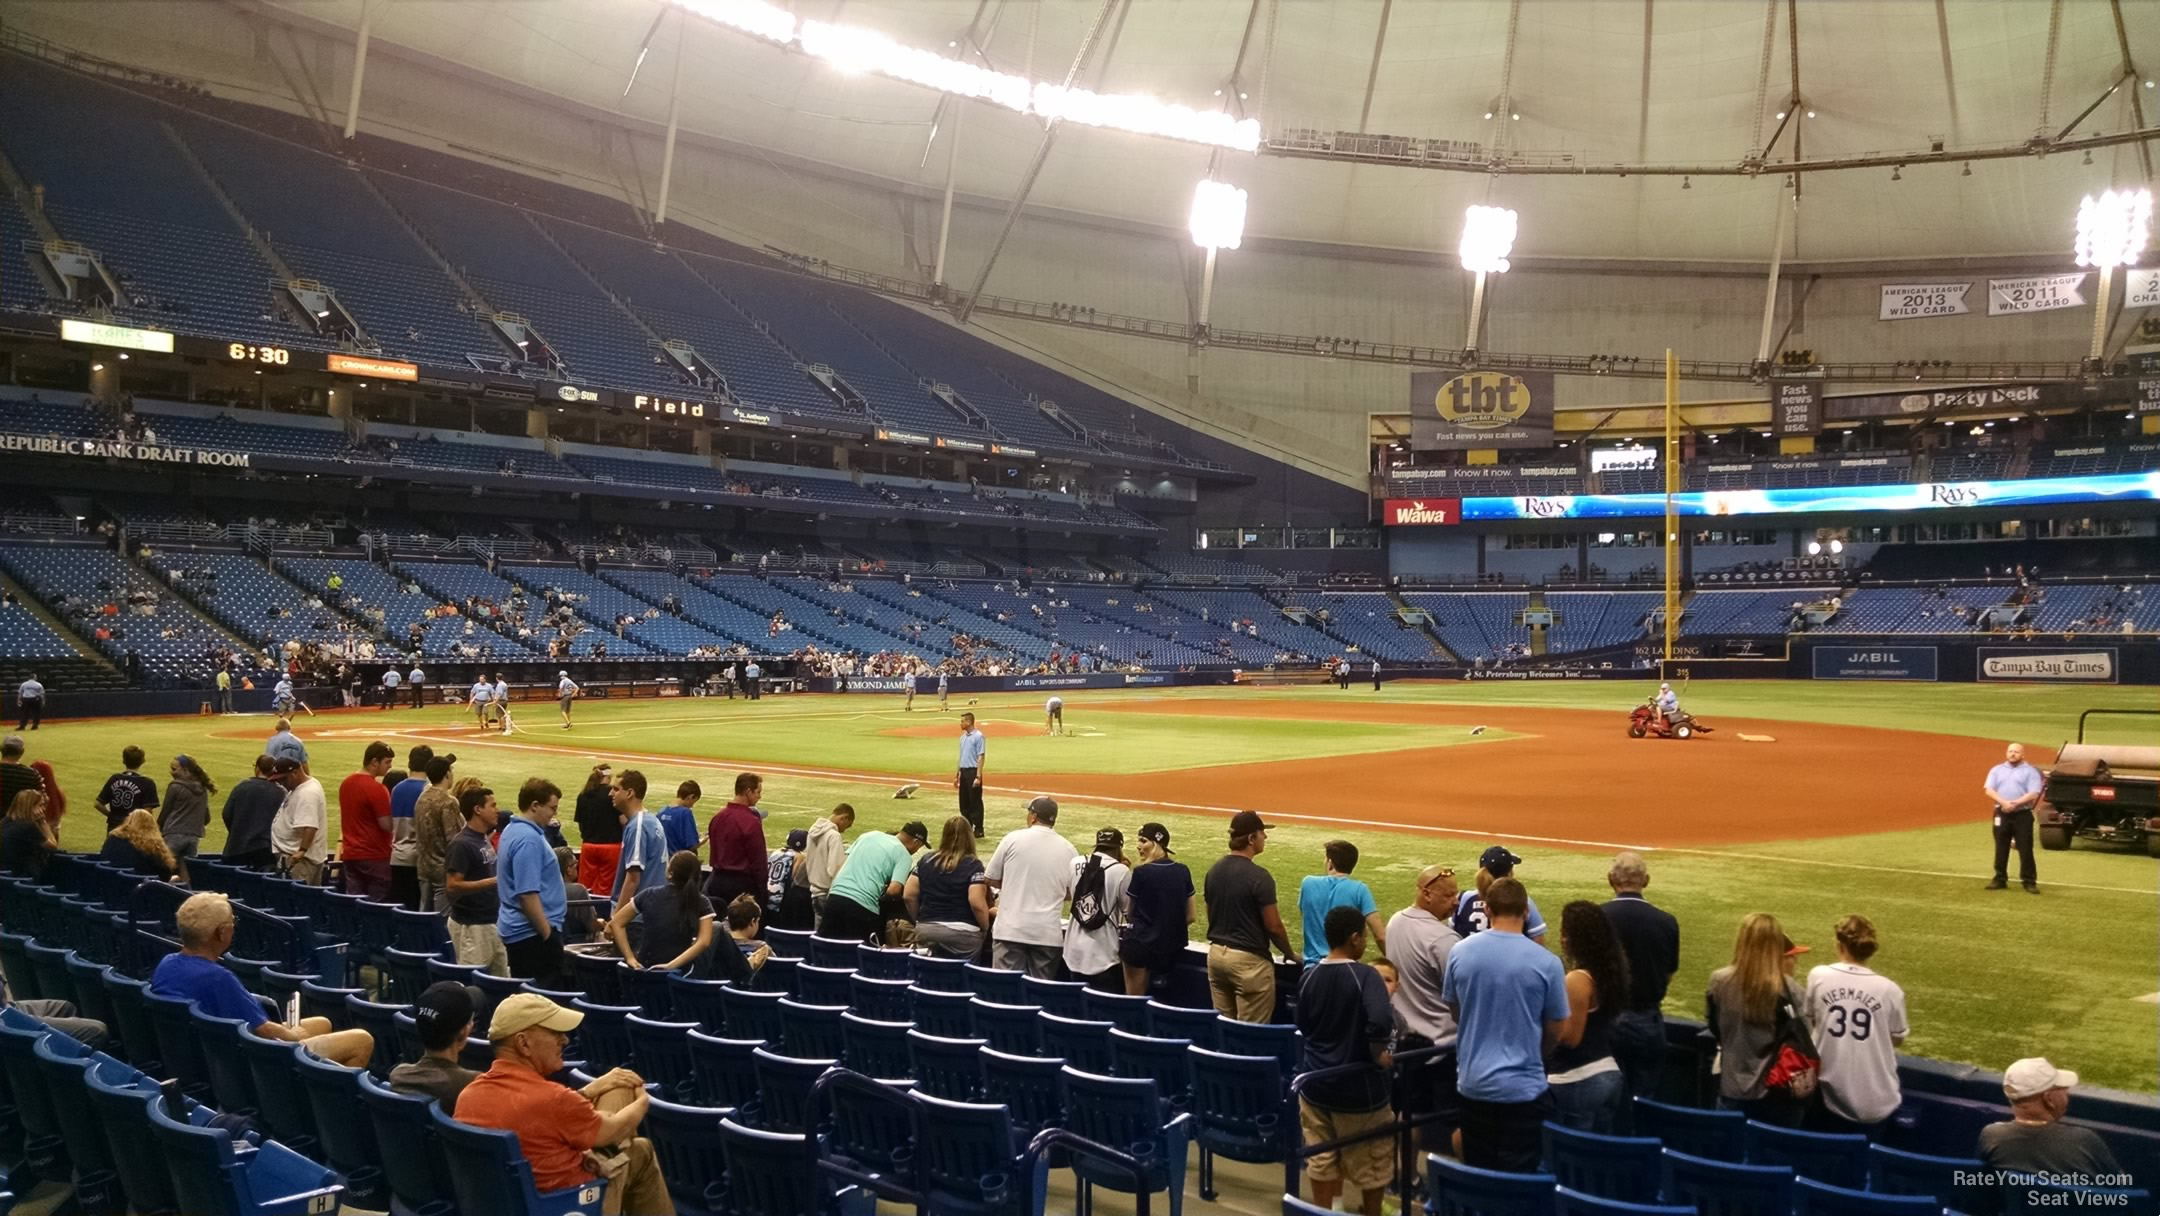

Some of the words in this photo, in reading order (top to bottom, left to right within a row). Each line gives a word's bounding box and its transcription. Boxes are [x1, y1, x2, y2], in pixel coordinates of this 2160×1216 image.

[1992, 281, 2038, 290] AMERICAN
[2041, 277, 2077, 286] LEAGUE
[1884, 288, 1928, 296] AMERICAN
[1931, 285, 1964, 293] LEAGUE
[2012, 286, 2058, 301] 2011
[1902, 294, 1946, 307] 2013
[1999, 303, 2029, 311] WILD
[2035, 298, 2070, 308] CARD
[1890, 307, 1918, 316] WILD
[1923, 305, 1956, 314] CARD
[229, 343, 289, 365] 6:30
[580, 390, 598, 402] SUN
[1448, 376, 1518, 414] tbt
[1782, 385, 1808, 396] Fast
[1992, 386, 2040, 403] Deck
[634, 395, 704, 417] Field
[1780, 395, 1813, 405] news
[1785, 405, 1808, 416] you
[1457, 415, 1477, 423] TAMPA
[1492, 415, 1512, 423] TIMES
[1785, 414, 1808, 423] can
[1784, 424, 1809, 432] use.
[1436, 432, 1454, 440] Fast
[1478, 432, 1494, 441] you
[0, 435, 81, 455] REPUBLIC
[83, 441, 134, 459] BANK
[137, 446, 193, 463] DRAFT
[197, 451, 249, 468] ROOM
[2129, 443, 2156, 453] Know
[1772, 461, 1794, 470] Know
[1795, 461, 1801, 469] it
[1391, 469, 1447, 479] tampabay.com
[1454, 468, 1482, 478] Know
[1482, 468, 1489, 477] it
[1491, 468, 1513, 477] now.
[1520, 466, 1577, 476] tampabay.com
[1396, 507, 1445, 524] Wawa
[1635, 646, 1649, 655] 162
[1652, 646, 1700, 655] LADING
[1848, 653, 1901, 663] JABIL
[1676, 668, 1690, 677] 315
[1989, 660, 2033, 675] Tampa
[2034, 660, 2061, 675] Bay
[2063, 659, 2105, 674] Times
[1065, 677, 1087, 685] COMMUNITY
[1473, 670, 1485, 678] St.
[1486, 670, 1528, 680] Petersburg
[1529, 670, 1564, 678] Welcomes
[1565, 670, 1581, 678] You!
[111, 787, 136, 810] 39
[1820, 987, 1882, 1013] KIERMAIER
[418, 1007, 440, 1020] PINK
[1827, 1004, 1872, 1042] 39
[586, 1189, 593, 1203] G
[316, 1196, 326, 1213] H
